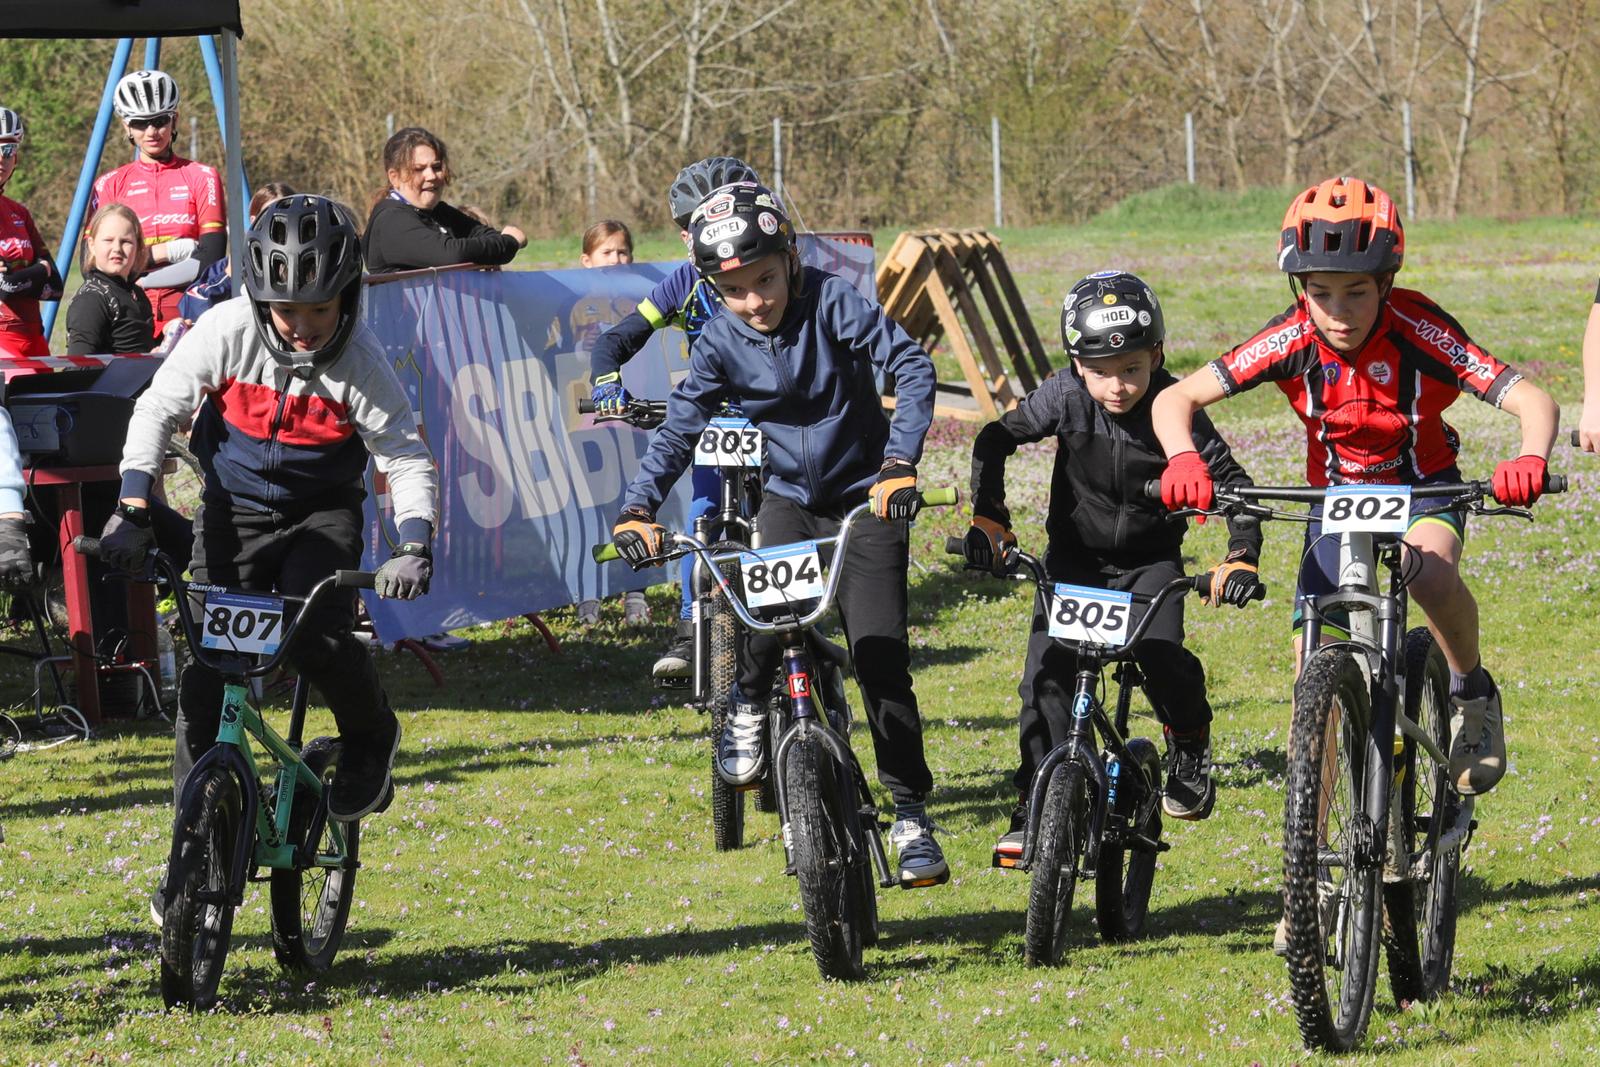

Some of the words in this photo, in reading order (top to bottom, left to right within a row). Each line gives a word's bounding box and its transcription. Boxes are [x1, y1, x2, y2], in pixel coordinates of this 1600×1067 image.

[207, 177, 216, 206] SOKOL
[152, 213, 196, 225] SOKOL
[700, 430, 759, 454] 803
[1328, 496, 1406, 521] 802
[747, 556, 818, 593] 804
[207, 606, 282, 641] 807
[1055, 598, 1127, 631] 805
